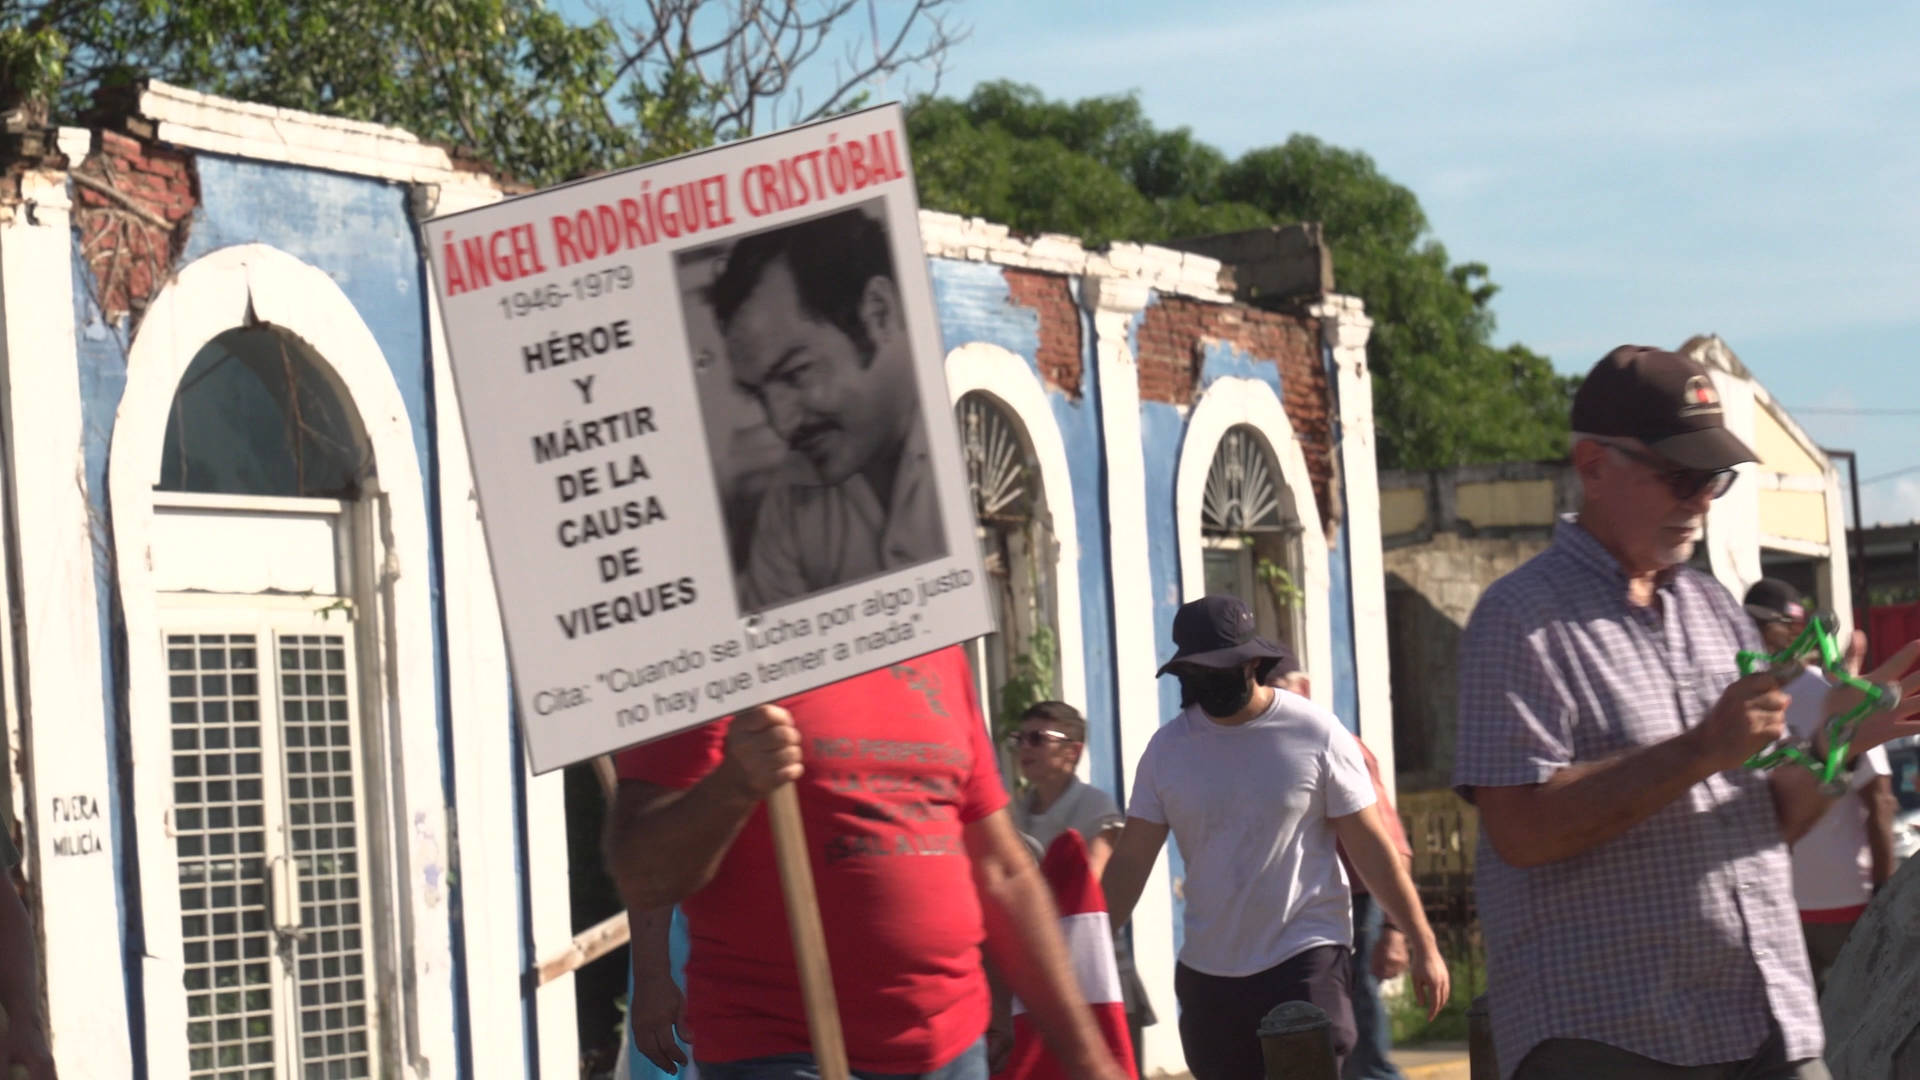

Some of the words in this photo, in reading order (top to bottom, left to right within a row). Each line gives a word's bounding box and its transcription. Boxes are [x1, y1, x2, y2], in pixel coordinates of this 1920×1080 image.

[443, 223, 546, 297] ÁNGEL
[550, 174, 735, 267] RODRÍGUEZ
[741, 131, 904, 217] CRISTÓBAL
[500, 265, 634, 319] 1946-1979
[521, 319, 634, 373] HÉROE
[572, 374, 595, 404] Y
[531, 406, 658, 464] MÁRTIR
[556, 466, 601, 503] DE
[607, 454, 651, 488] LA
[558, 495, 668, 548] CAUSA
[598, 547, 643, 583] DE
[555, 576, 697, 640] VIEQUES
[533, 685, 592, 716] Cita:
[710, 640, 740, 662] se
[746, 617, 811, 650] lucha
[817, 603, 858, 636] por
[863, 587, 914, 616] algo
[916, 568, 974, 607] justo
[616, 704, 650, 728] no
[653, 687, 699, 714] hay
[705, 672, 752, 703] que
[758, 648, 826, 684] temer
[833, 642, 850, 661] a
[52, 795, 100, 822] FUERA
